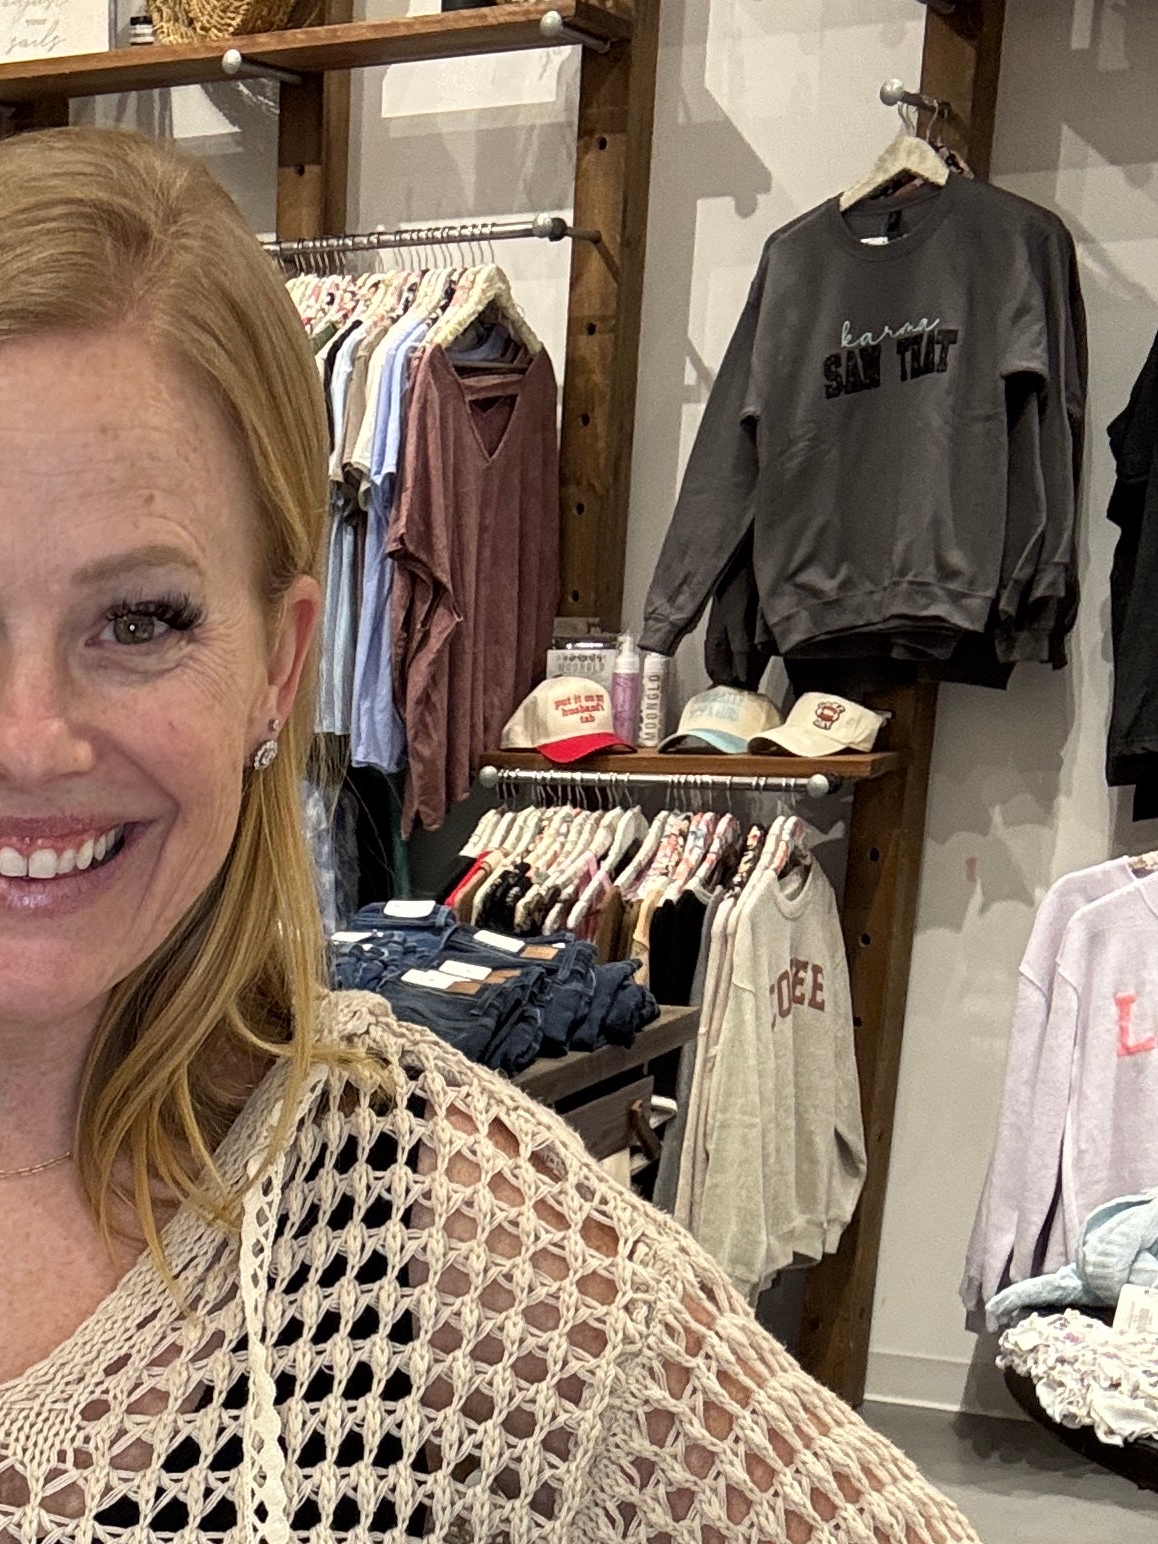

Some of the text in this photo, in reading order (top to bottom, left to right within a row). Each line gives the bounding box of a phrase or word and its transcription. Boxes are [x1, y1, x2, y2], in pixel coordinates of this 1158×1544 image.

[841, 317, 940, 348] karma
[553, 696, 572, 710] put
[579, 714, 595, 723] tab
